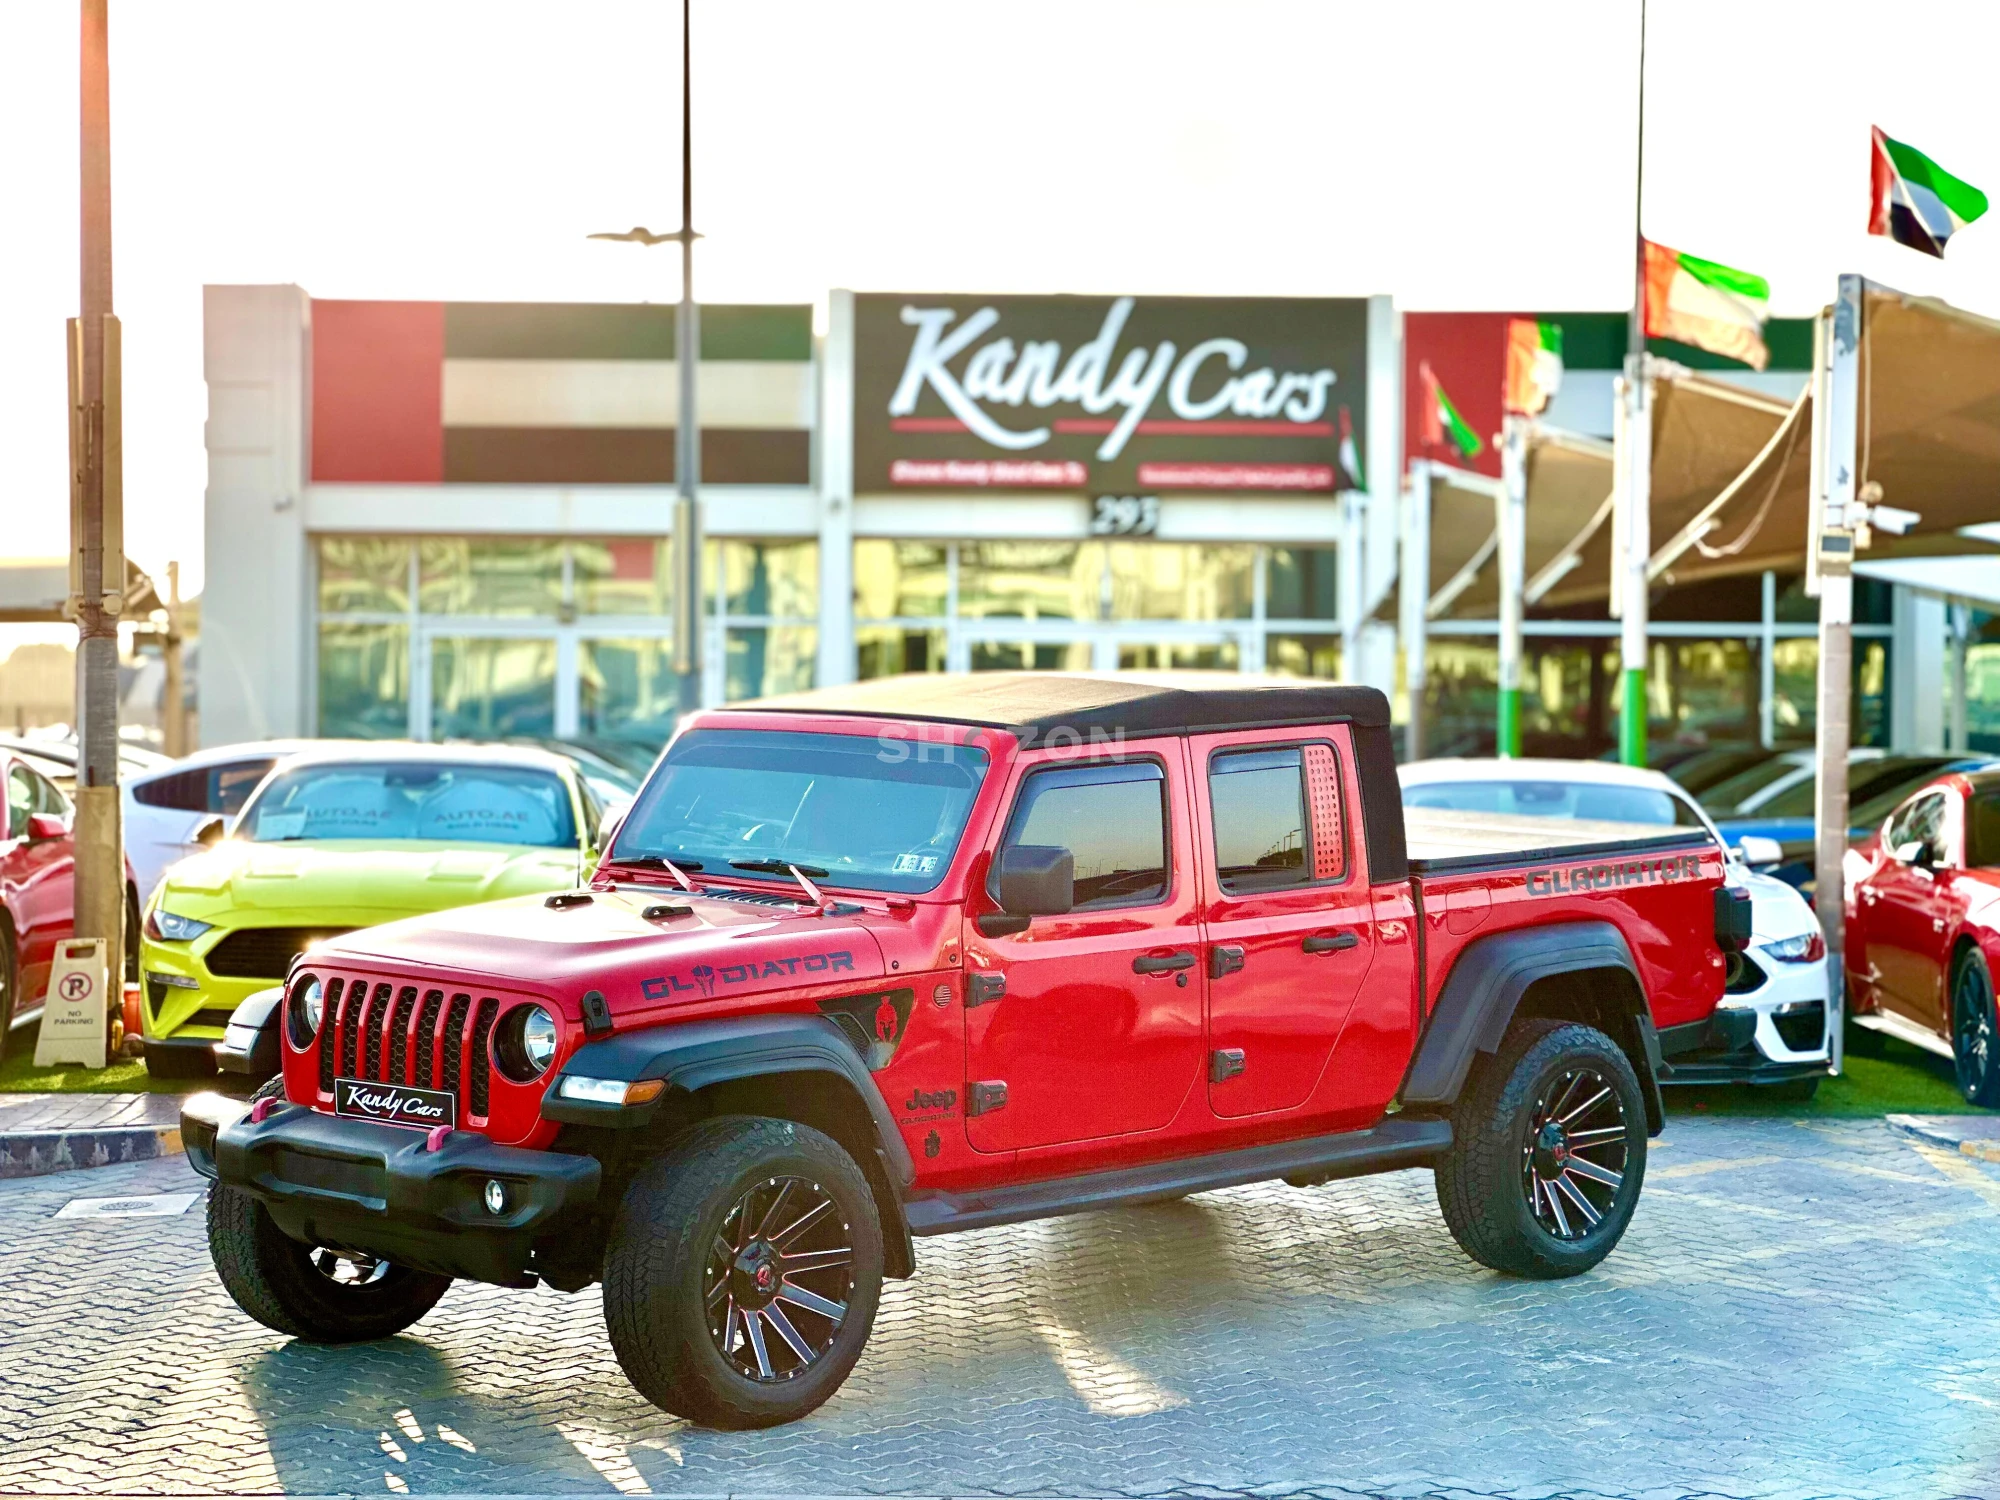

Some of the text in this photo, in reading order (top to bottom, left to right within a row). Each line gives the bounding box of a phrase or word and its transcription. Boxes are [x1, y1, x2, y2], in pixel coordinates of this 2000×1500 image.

[888, 296, 1337, 461] Kandy Cars
[1526, 855, 1703, 897] GLADIATOR
[347, 1086, 443, 1118] Kandy Cars
[906, 1088, 957, 1111] Jeep
